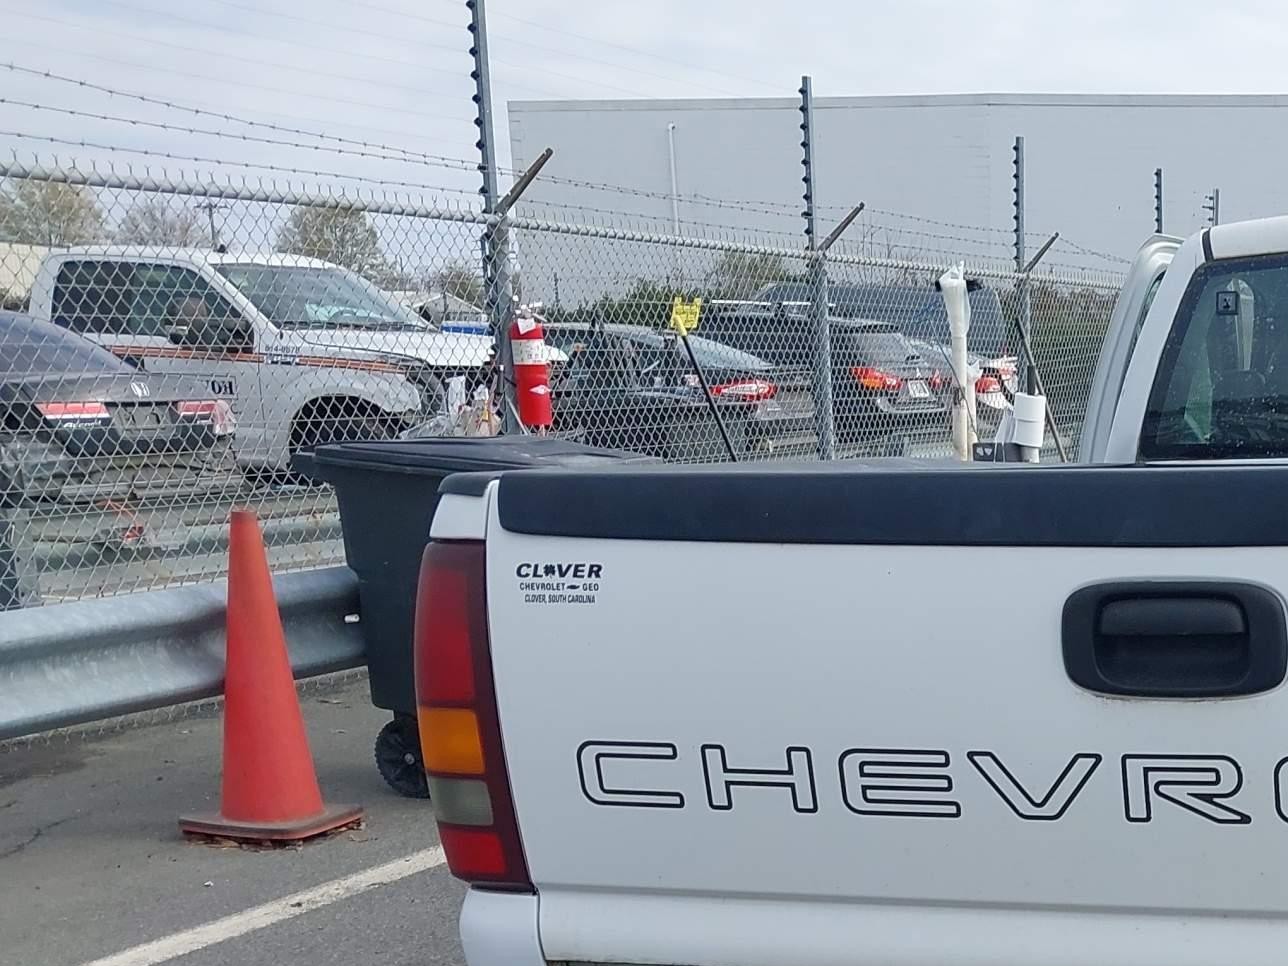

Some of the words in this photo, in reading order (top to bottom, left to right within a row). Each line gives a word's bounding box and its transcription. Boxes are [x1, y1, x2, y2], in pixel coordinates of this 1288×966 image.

[516, 563, 602, 578] CLOVER
[519, 582, 566, 591] CHEVROLET
[582, 582, 599, 591] GEO
[524, 593, 547, 604] CLOVER,
[548, 594, 567, 604] SOUTH
[567, 594, 596, 604] CAROLINA
